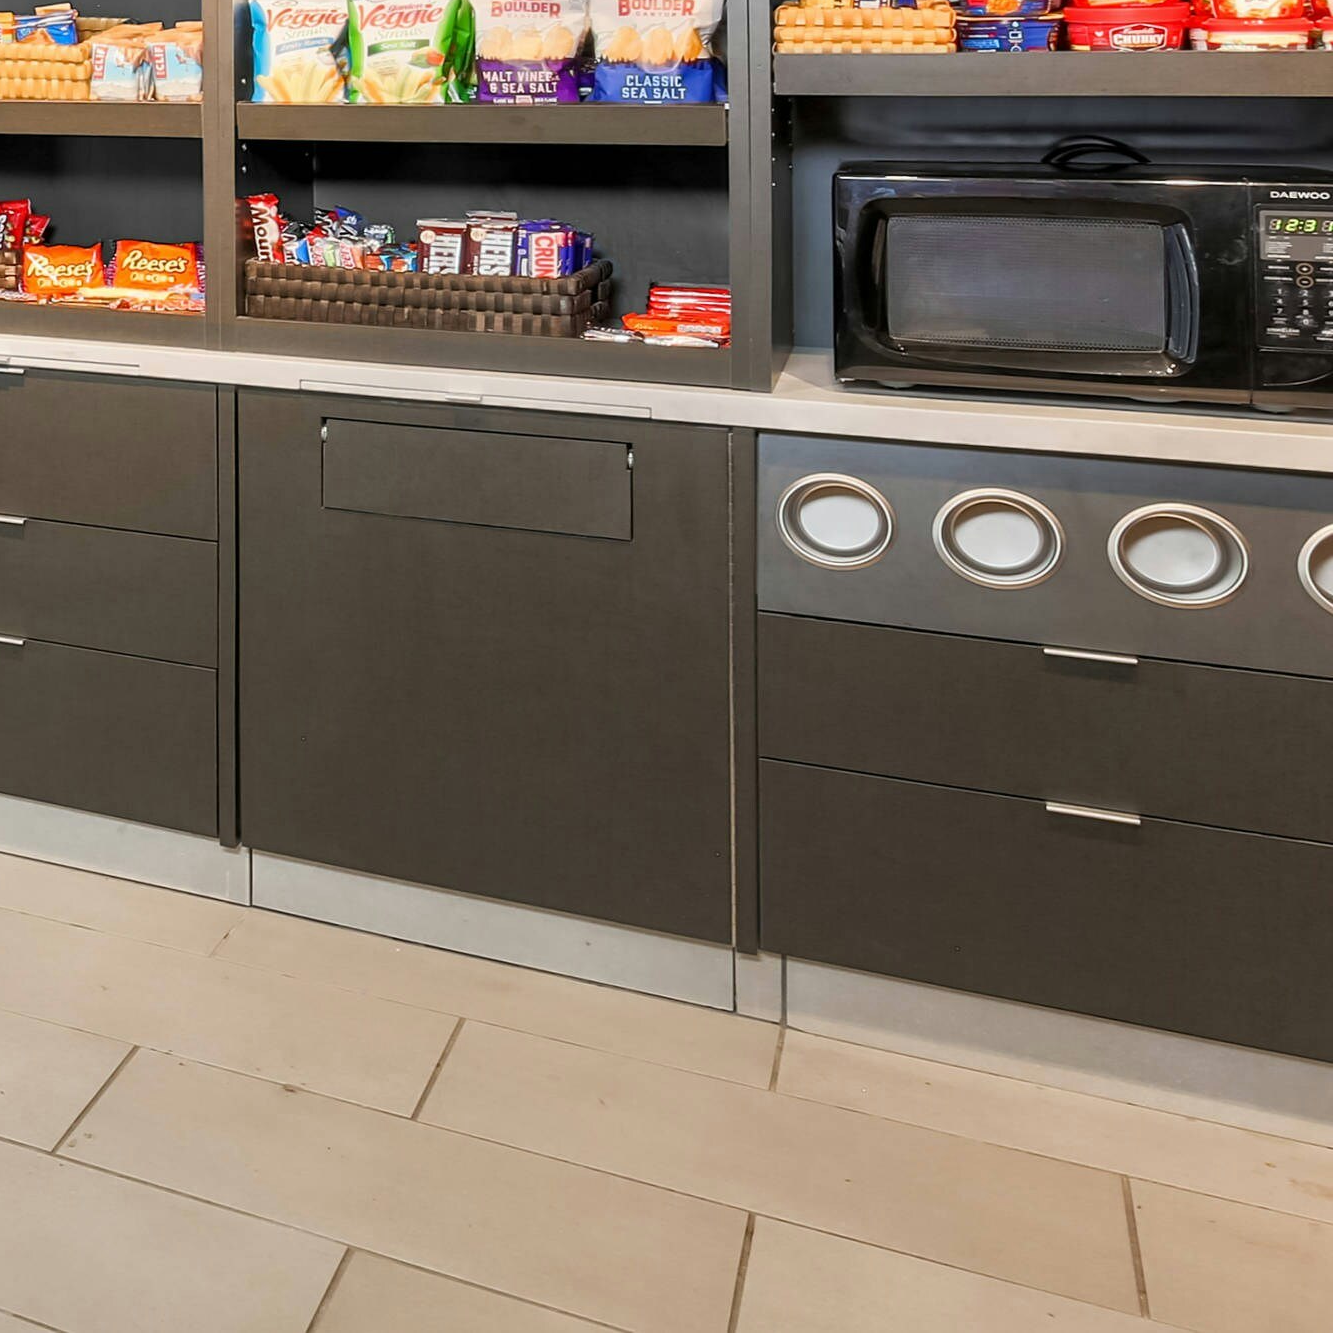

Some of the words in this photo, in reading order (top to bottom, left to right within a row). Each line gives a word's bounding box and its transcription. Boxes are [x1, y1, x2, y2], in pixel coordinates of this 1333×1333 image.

[358, 3, 444, 31] Veggie
[491, 0, 561, 18] BOULDER
[266, 8, 348, 32] Veggie
[1113, 34, 1165, 45] CHUNKY
[482, 71, 513, 83] MALT
[626, 75, 683, 87] CLASSIC
[489, 83, 498, 93] &
[502, 83, 525, 94] SEA
[529, 82, 558, 94] SALT
[622, 87, 648, 99] SEA
[653, 88, 687, 99] SALT
[1270, 191, 1331, 199] DAEWOO
[122, 249, 188, 273] Reese's
[478, 230, 514, 276] HERS
[534, 235, 555, 279] CRUN
[27, 255, 95, 278] Reese's
